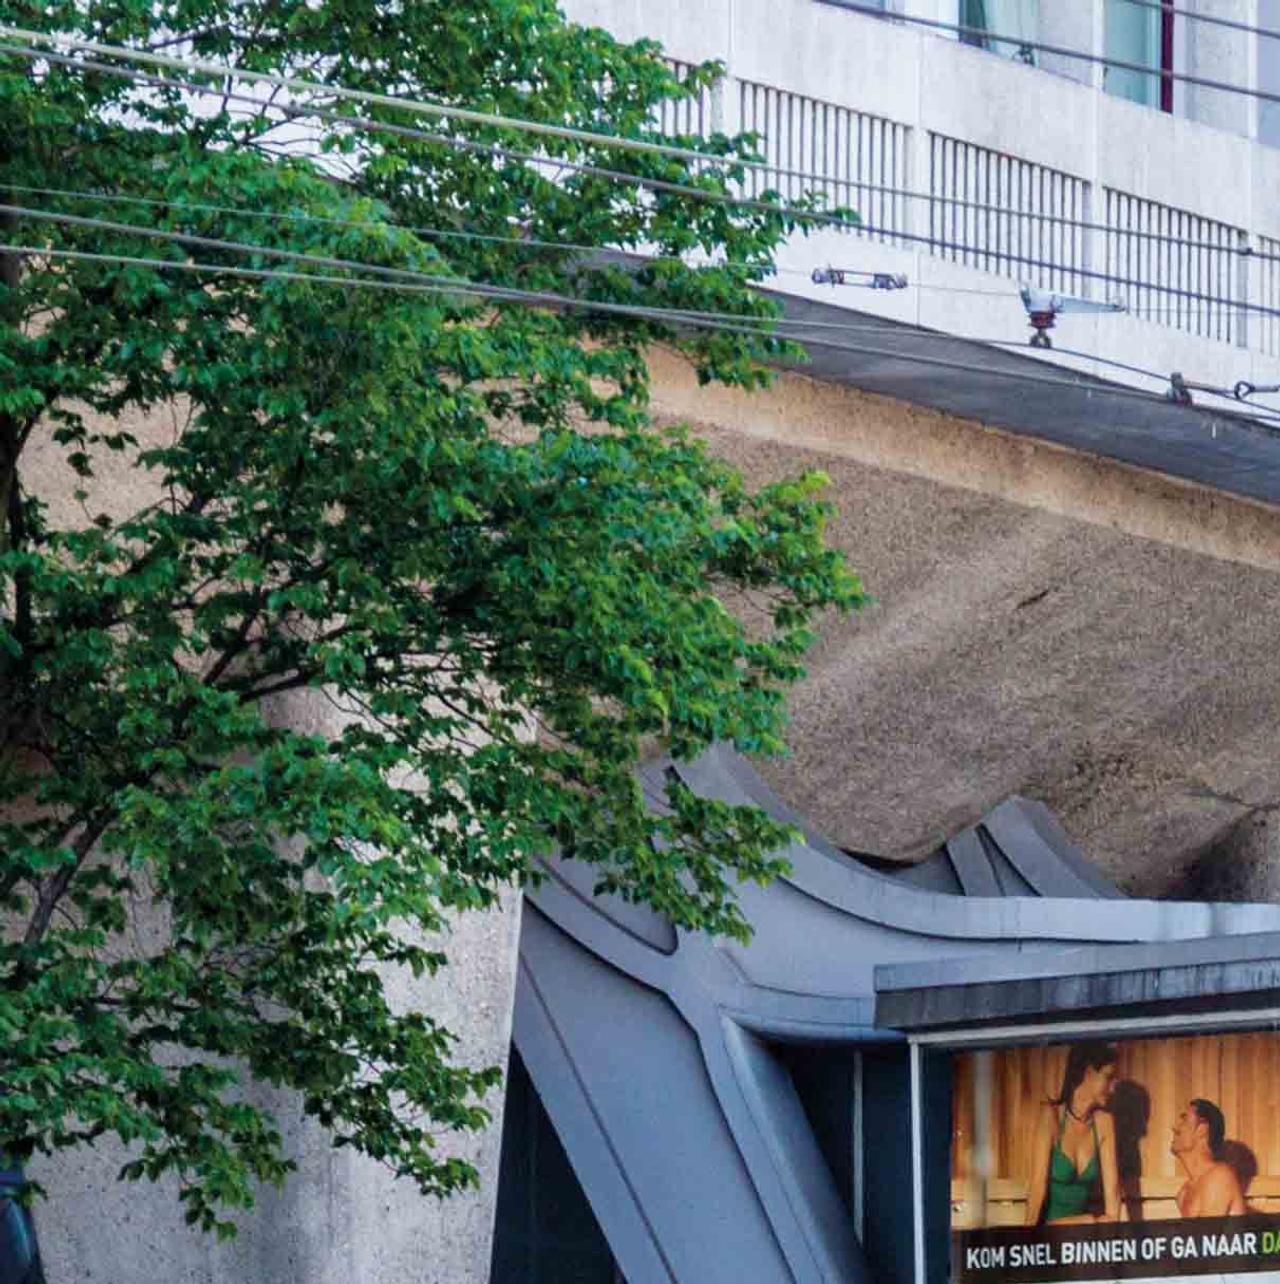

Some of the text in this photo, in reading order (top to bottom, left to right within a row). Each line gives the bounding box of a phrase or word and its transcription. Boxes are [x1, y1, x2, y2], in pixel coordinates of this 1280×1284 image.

[966, 1246, 1005, 1269] KOM
[1009, 1243, 1056, 1267] SNEL
[1060, 1239, 1137, 1265] BINNEN
[1141, 1237, 1167, 1261] OF
[1170, 1236, 1198, 1260] GA
[1202, 1232, 1257, 1257] NAAR
